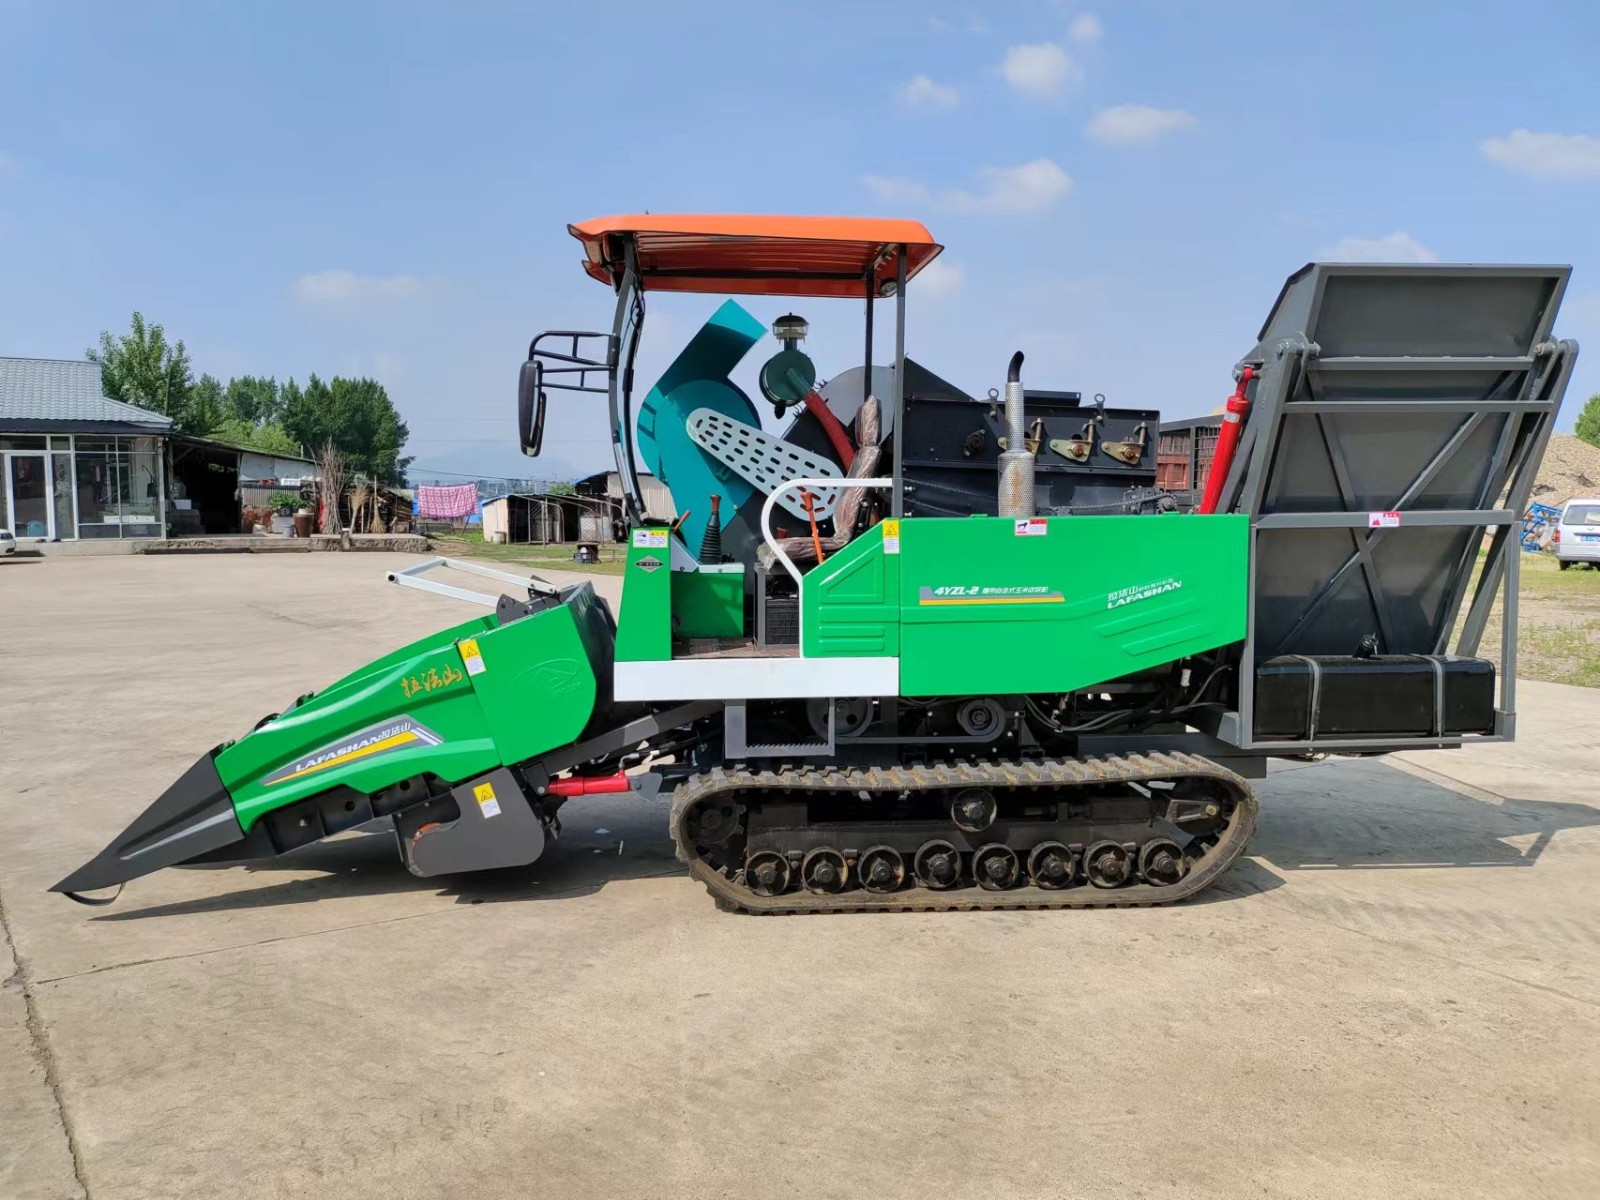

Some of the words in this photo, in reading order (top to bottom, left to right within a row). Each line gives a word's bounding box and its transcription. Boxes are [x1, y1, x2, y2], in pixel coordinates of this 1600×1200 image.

[934, 586, 980, 595] 4YZL-2
[1107, 580, 1182, 609] LAFASHAN
[296, 734, 382, 772] LAFASHAN
